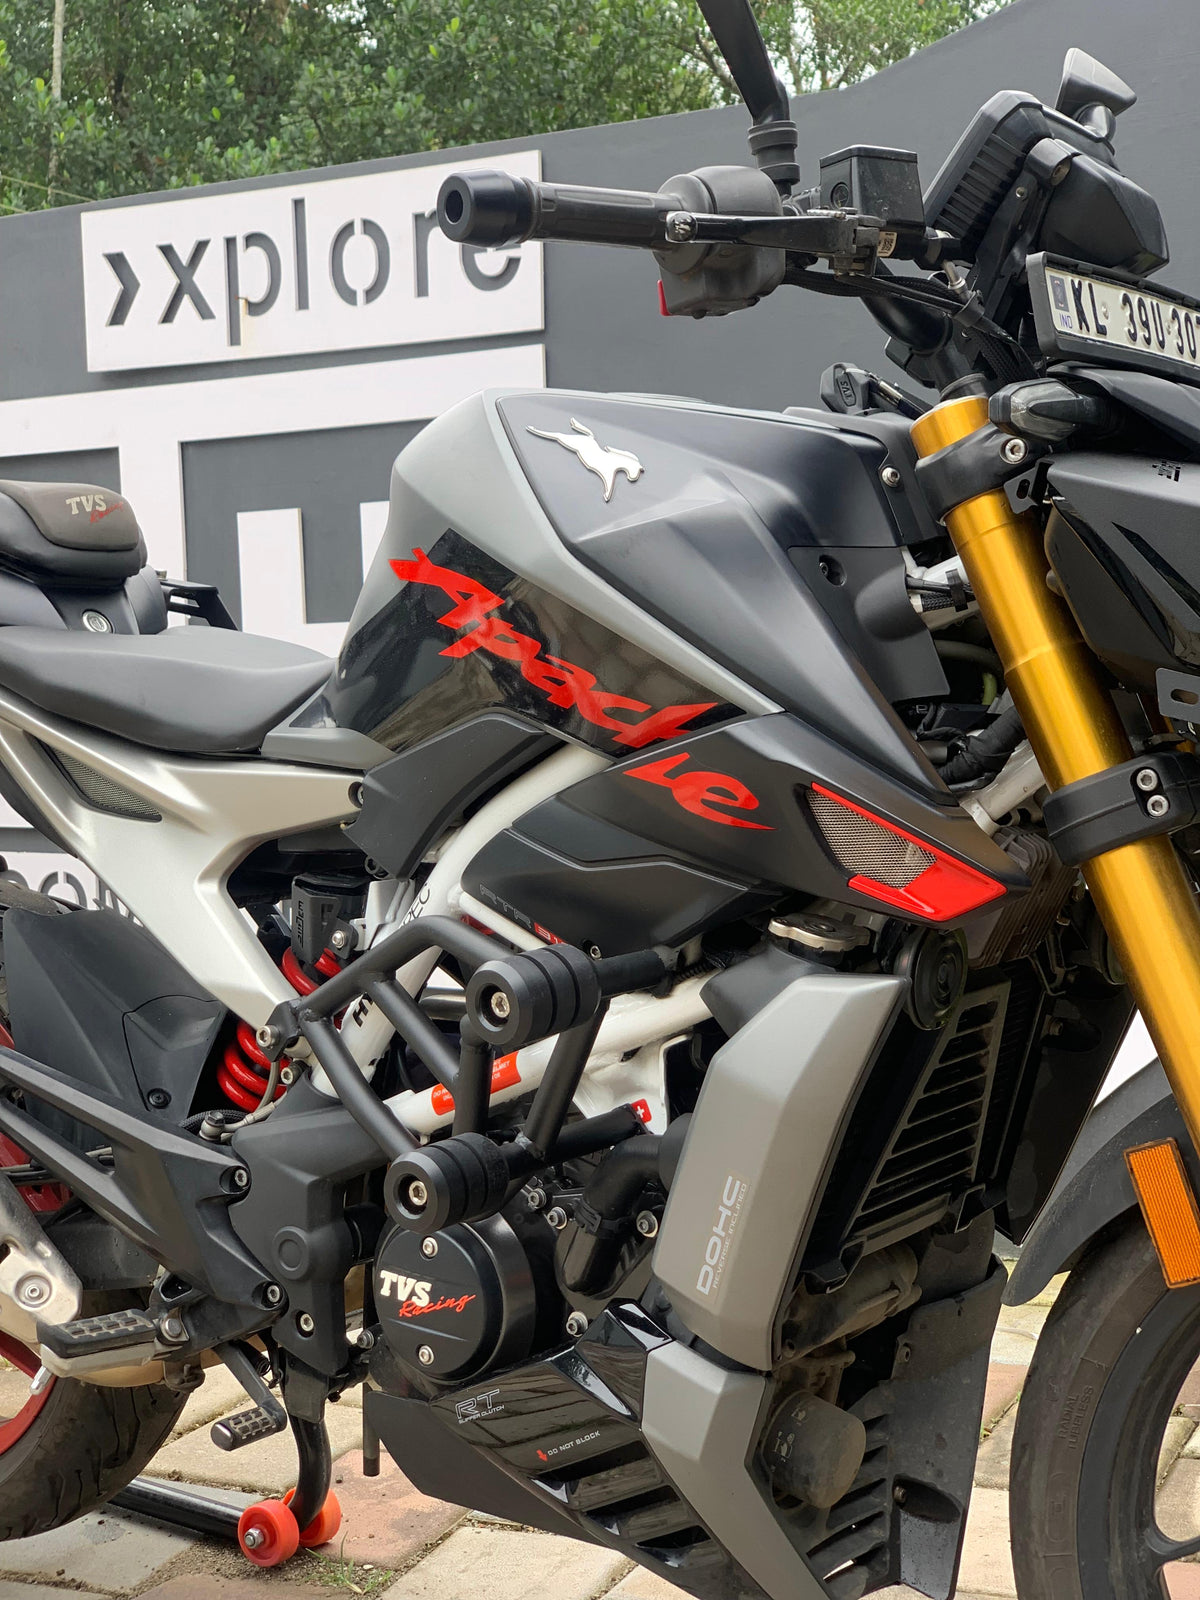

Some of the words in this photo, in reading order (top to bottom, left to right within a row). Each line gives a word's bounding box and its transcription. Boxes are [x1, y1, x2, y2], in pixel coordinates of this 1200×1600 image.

[1059, 314, 1073, 329] IND
[1071, 279, 1107, 336] KL
[840, 381, 853, 399] TVS
[66, 494, 107, 515] TVS
[696, 1175, 741, 1295] DOHC
[712, 1236, 731, 1289] REVERSE
[728, 1183, 747, 1235] INCLINED
[380, 1269, 432, 1307] TVS
[399, 1294, 476, 1317] Racing
[455, 1388, 500, 1419] RT
[481, 1404, 505, 1417] CLUTCH
[1058, 1395, 1079, 1439] RADIAL
[1068, 1386, 1093, 1449] TUBELESS
[559, 1442, 574, 1451] NOT
[576, 1430, 601, 1445] BLOCK
